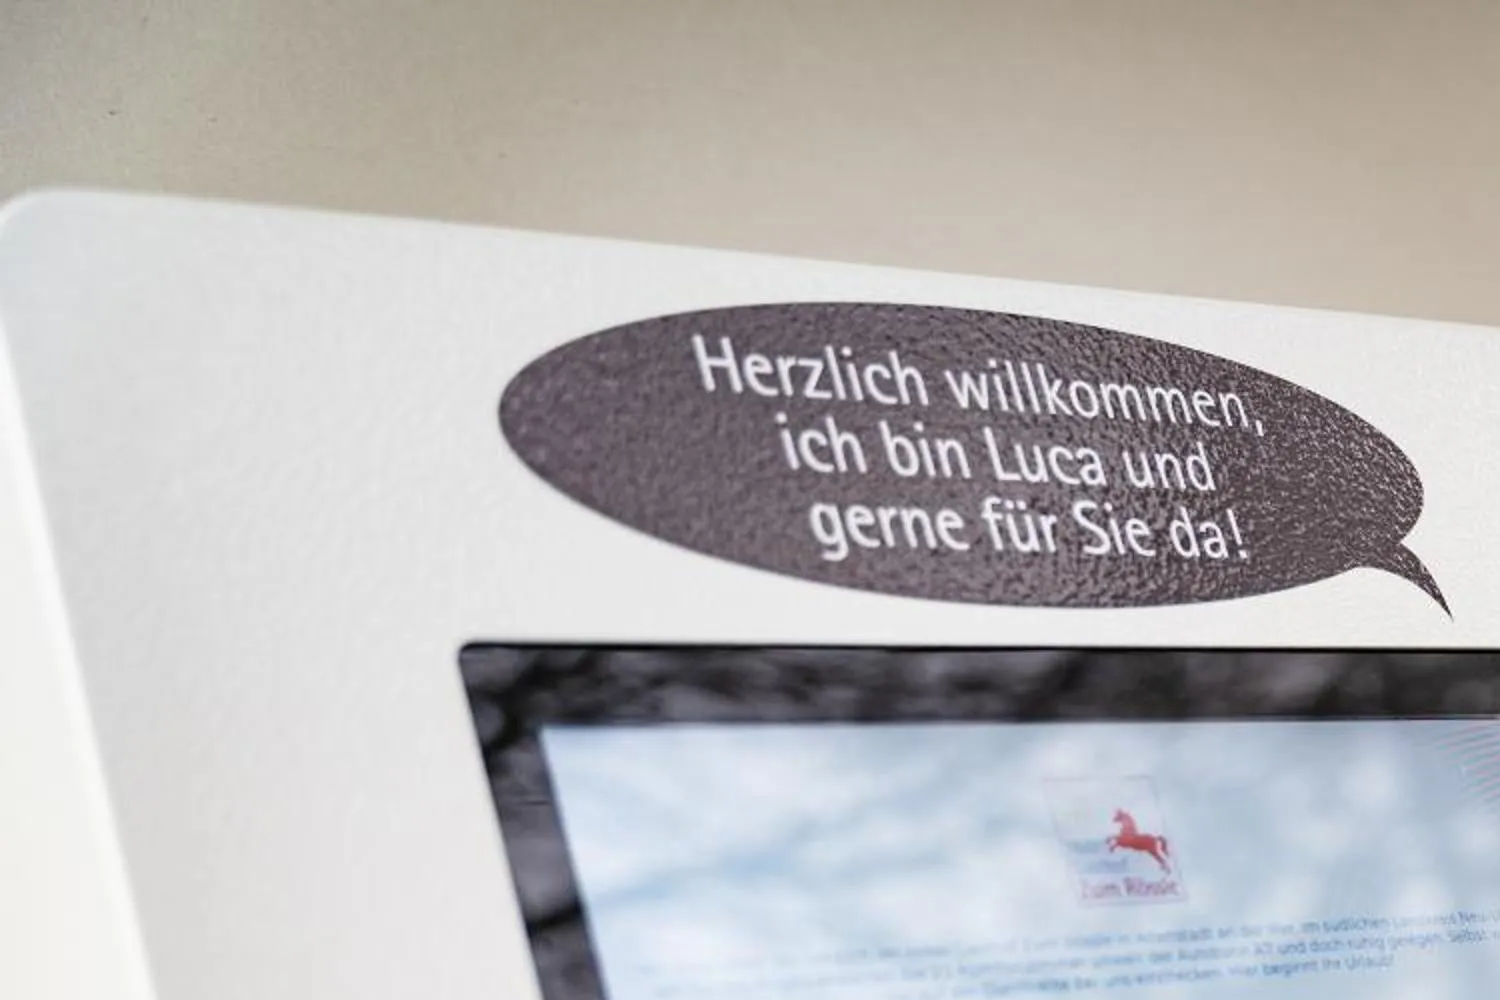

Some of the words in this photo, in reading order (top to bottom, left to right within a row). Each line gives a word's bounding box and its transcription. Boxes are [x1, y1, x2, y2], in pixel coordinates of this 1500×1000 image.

[690, 333, 927, 408] Herzlich
[944, 360, 1265, 436] willkommen,
[776, 412, 864, 476] ich
[880, 420, 972, 481] bin
[984, 426, 1105, 488] Luca
[1124, 442, 1214, 493] und
[810, 501, 968, 563] gerne
[982, 497, 1059, 553] für
[1078, 502, 1156, 557] Sie
[1167, 506, 1250, 561] da!
